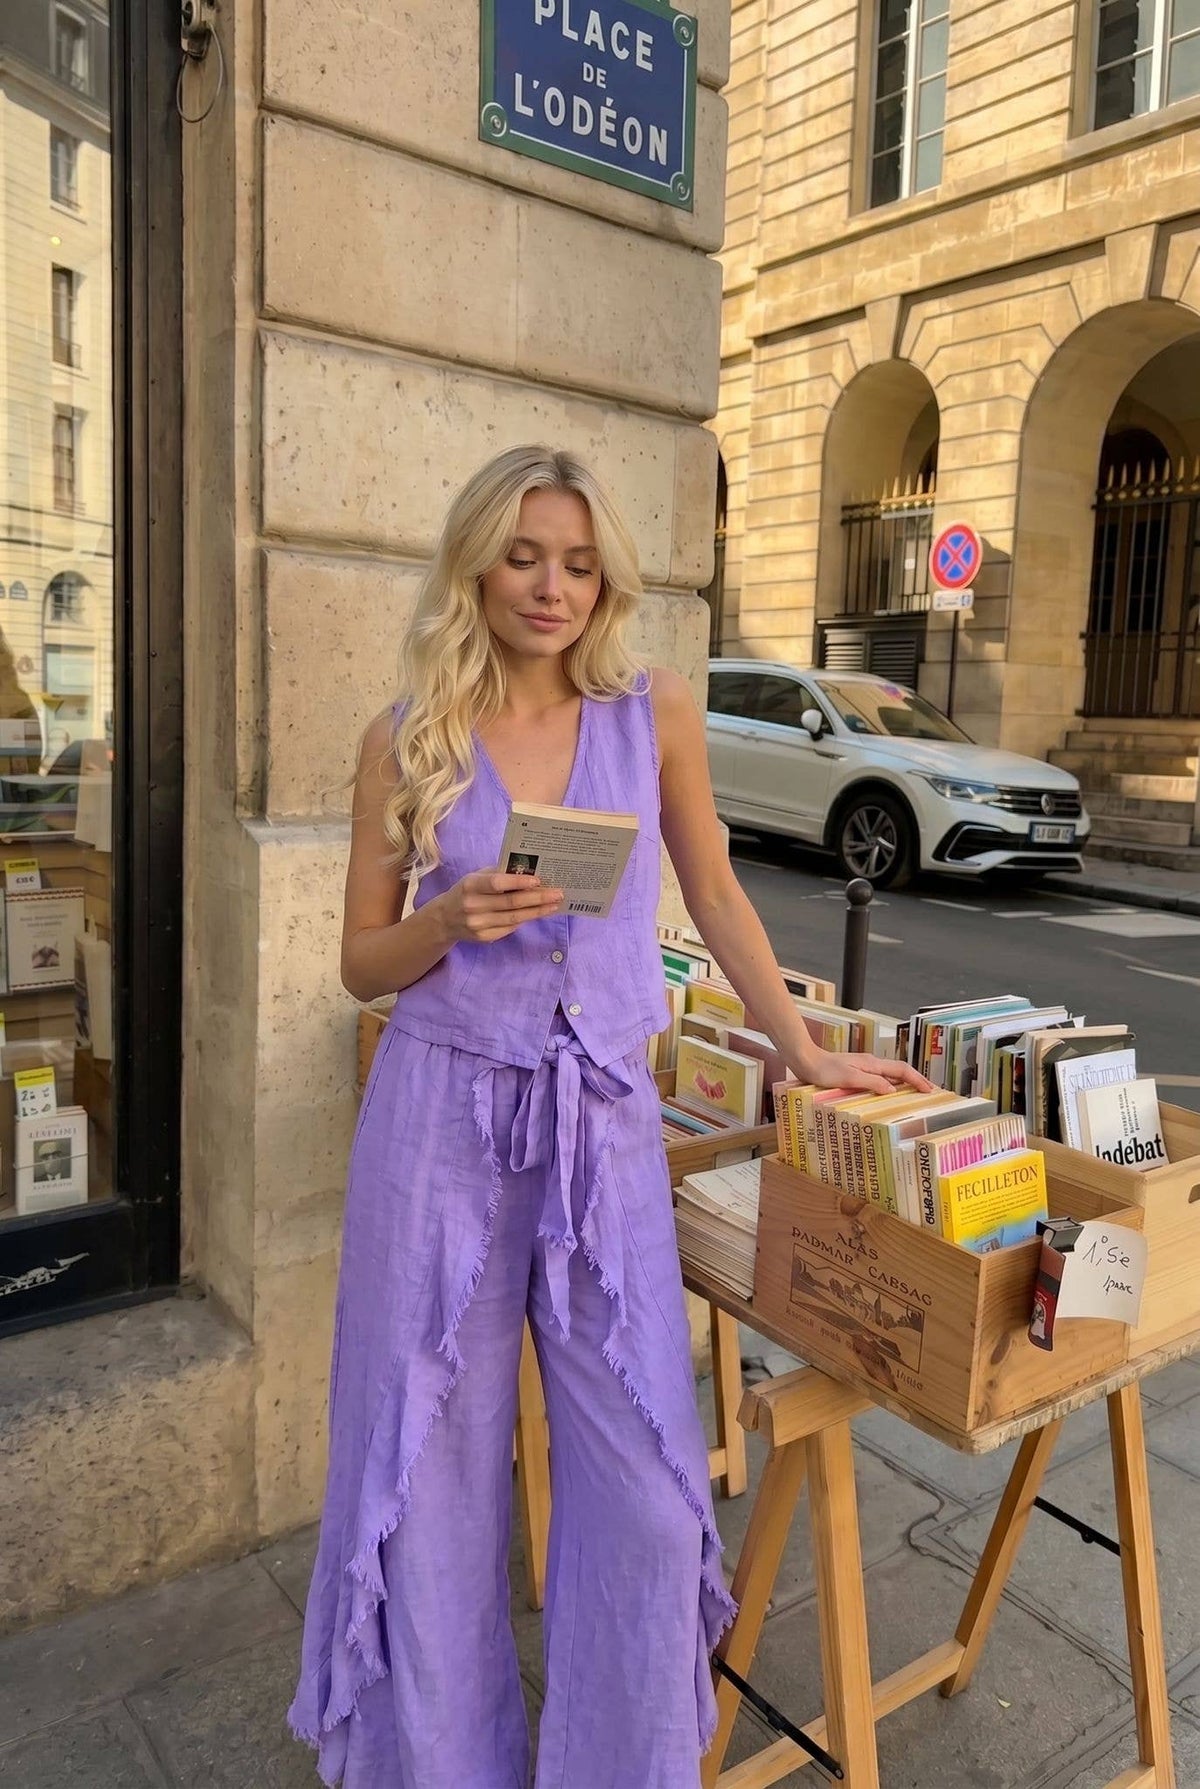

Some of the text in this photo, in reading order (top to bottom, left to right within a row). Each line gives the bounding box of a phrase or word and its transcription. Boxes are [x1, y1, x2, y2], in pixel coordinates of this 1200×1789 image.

[534, 0, 653, 72] PLACE
[582, 61, 607, 89] DE
[514, 72, 668, 166] L'ODÉON
[956, 1165, 1038, 1202] FECILLETON
